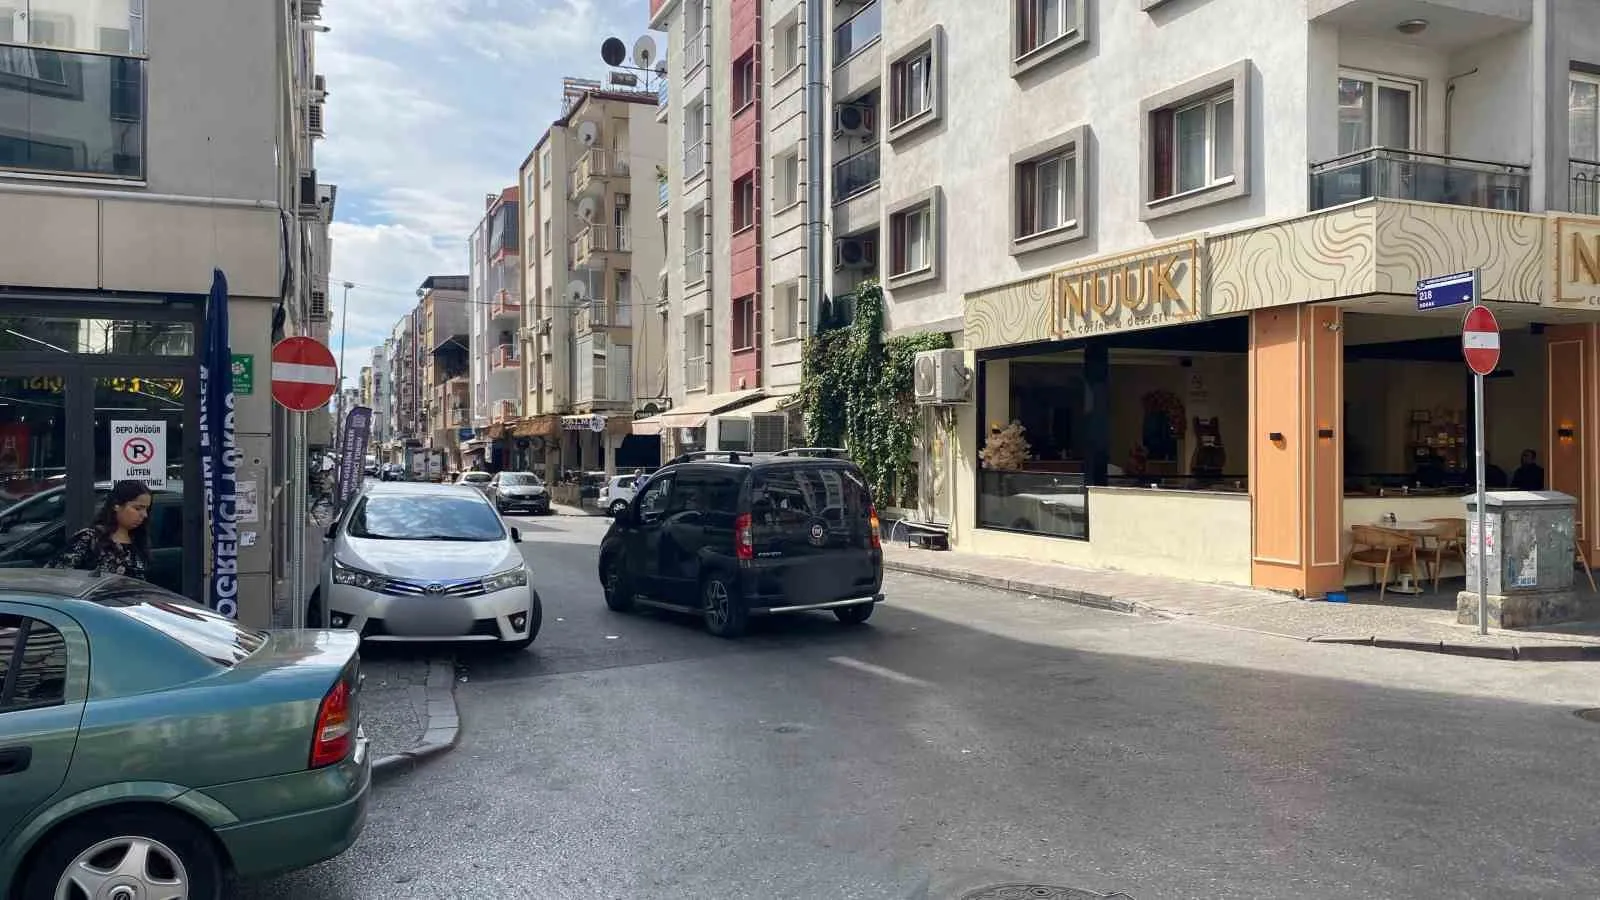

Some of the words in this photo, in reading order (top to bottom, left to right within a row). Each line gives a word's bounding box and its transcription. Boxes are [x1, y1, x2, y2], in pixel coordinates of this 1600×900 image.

[1059, 254, 1182, 319] NUUK
[1419, 290, 1433, 300] 218
[1127, 311, 1168, 327] dessert
[115, 426, 133, 434] DEPO
[126, 467, 151, 476] LÜTFEN
